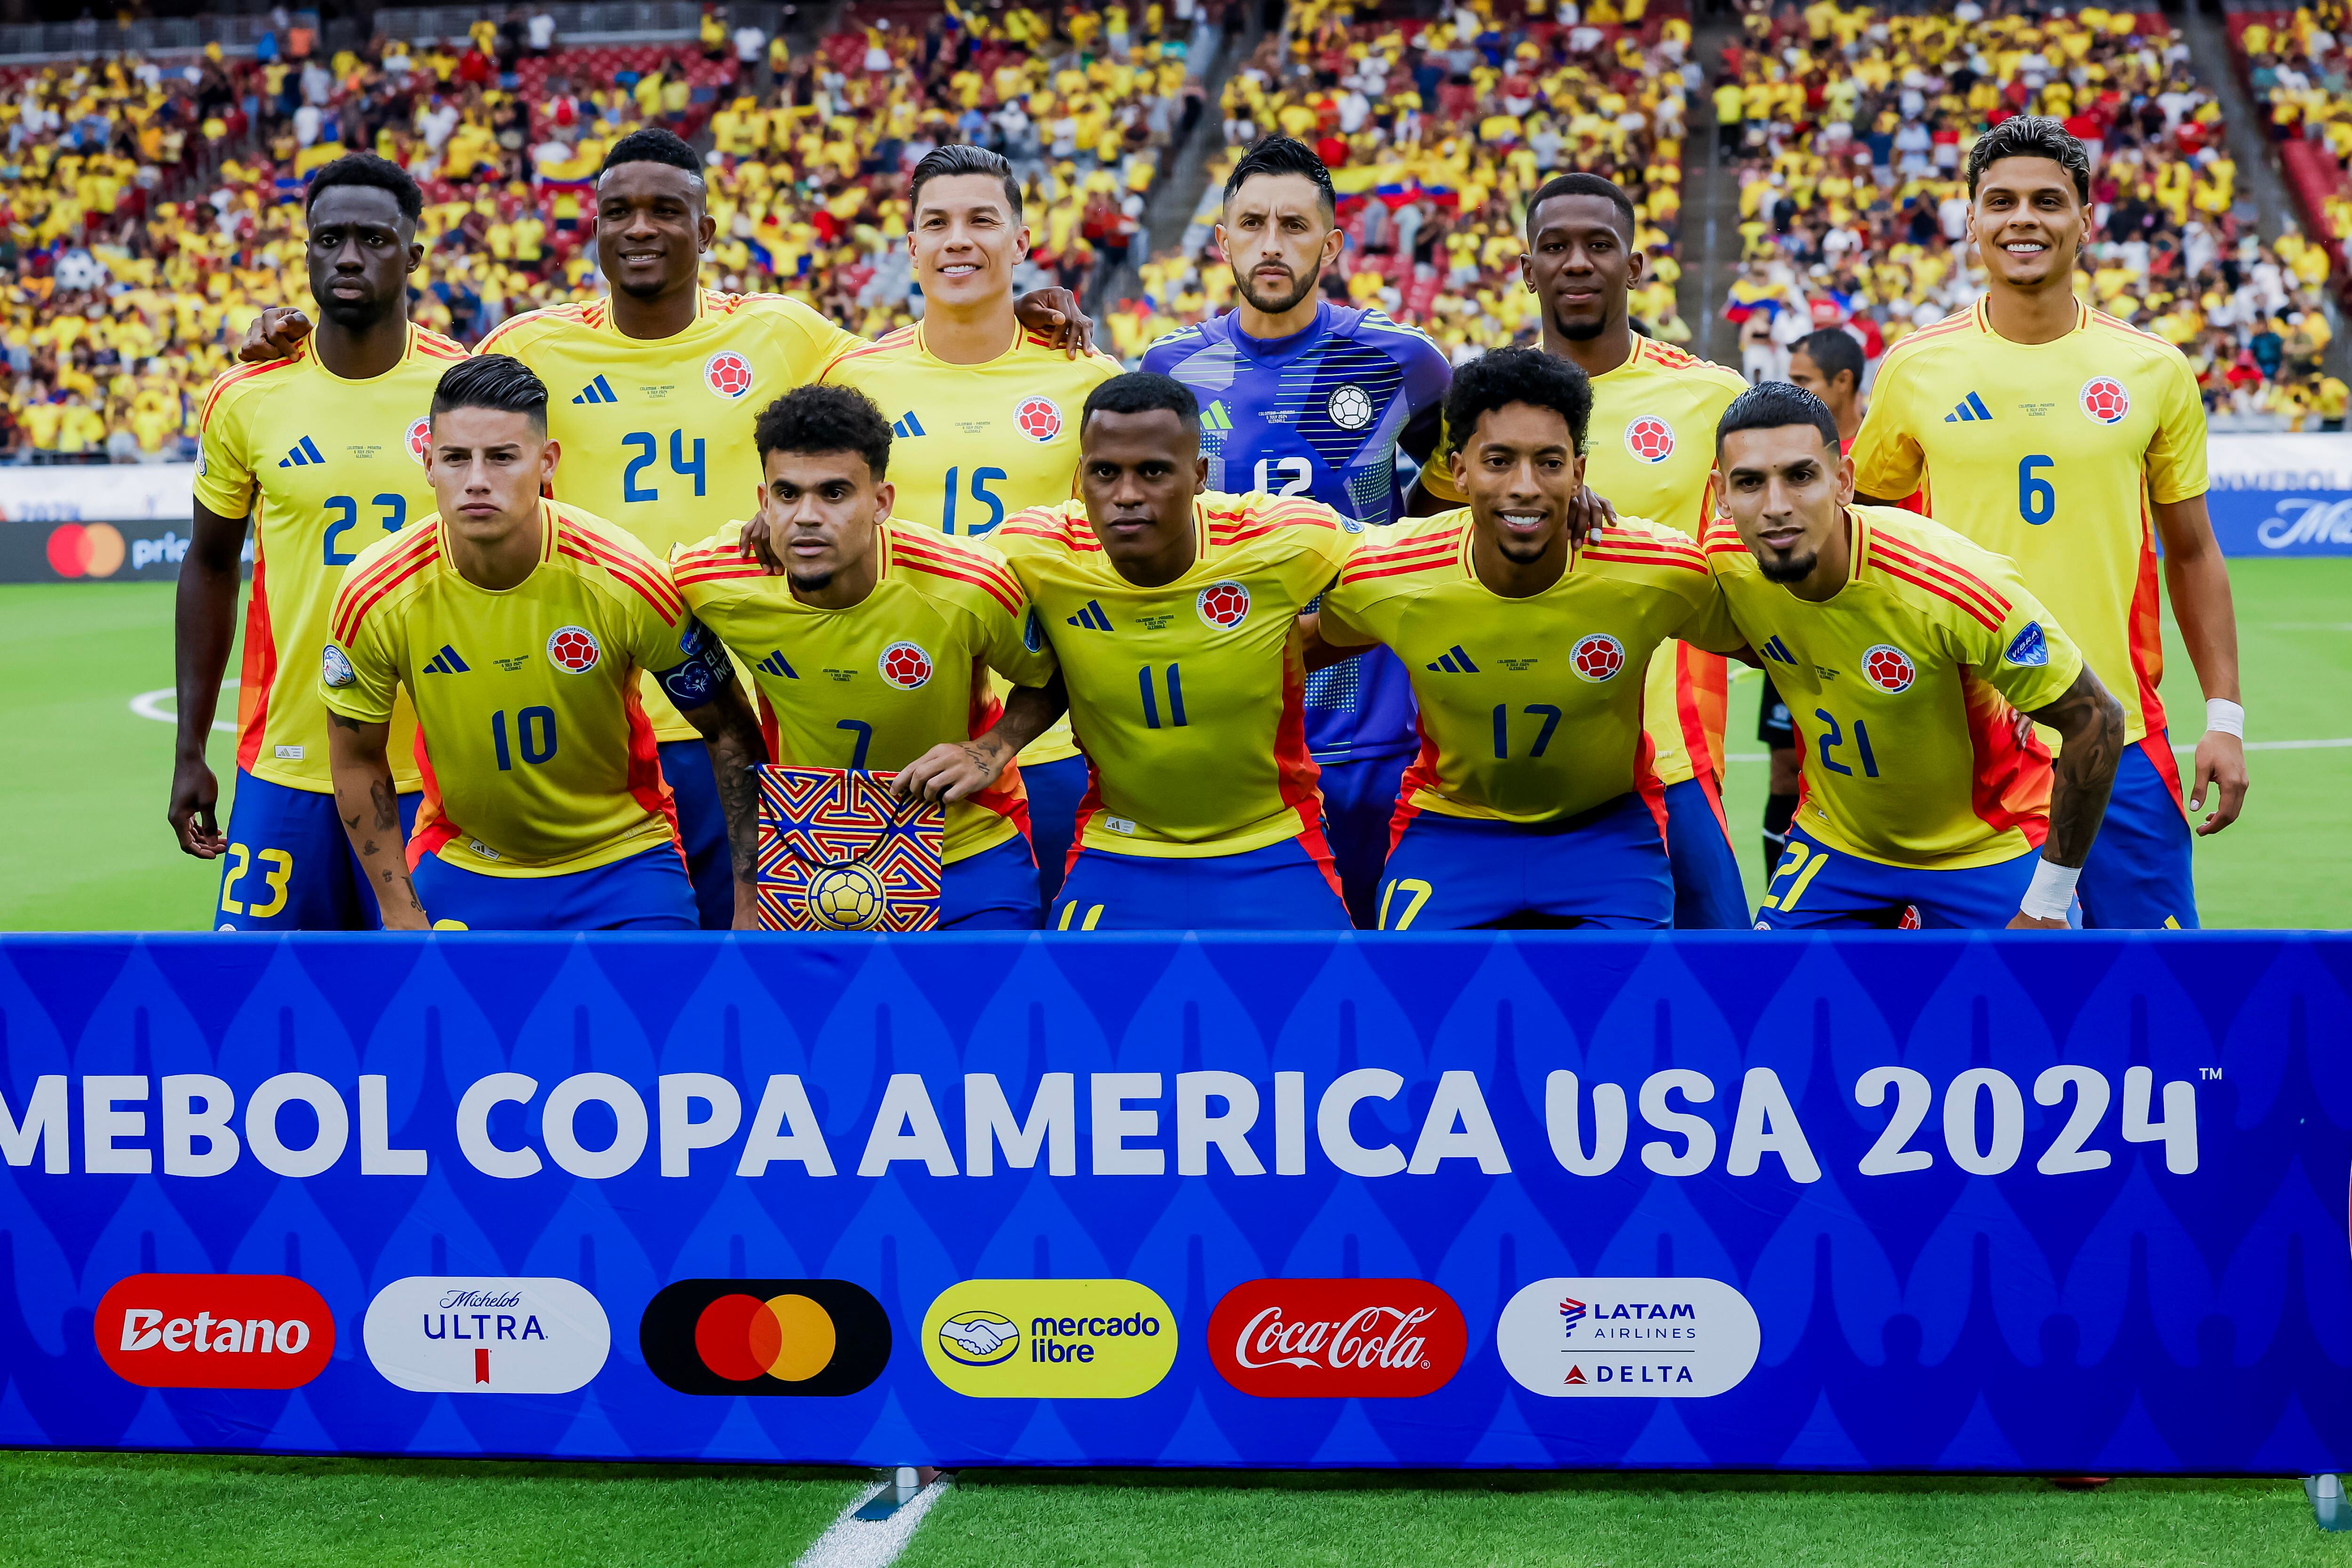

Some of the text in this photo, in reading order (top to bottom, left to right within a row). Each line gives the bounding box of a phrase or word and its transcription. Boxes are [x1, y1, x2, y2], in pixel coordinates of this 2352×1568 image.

[621, 429, 706, 502] 24
[1254, 456, 1312, 496] 12
[2018, 454, 2055, 525] 6
[942, 466, 1008, 536] 15
[132, 531, 192, 570] pric
[323, 493, 406, 565] 23
[2012, 630, 2038, 658] VIBRA
[1138, 663, 1187, 729] 11
[492, 705, 557, 771] 10
[836, 719, 873, 770] 7
[1493, 703, 1562, 759] 17
[1814, 708, 1880, 778] 21
[221, 842, 293, 918] 23
[1762, 841, 1829, 912] 21
[1378, 878, 1432, 931] 17
[456, 1072, 837, 1179] COPA
[857, 1068, 1512, 1177] AMERICA
[1546, 1067, 1821, 1183] USA
[1855, 1065, 2198, 1176] 2024
[439, 1289, 520, 1309] Michelob
[1032, 1312, 1160, 1337] mercado
[1594, 1304, 1695, 1320] LATAM
[120, 1309, 310, 1354] Betano
[424, 1314, 546, 1340] ULTRA
[1032, 1338, 1094, 1363] libre
[1236, 1306, 1437, 1369] Coca-Cola
[1594, 1328, 1696, 1339] AIRLINES
[1596, 1366, 1694, 1383] DELTA
